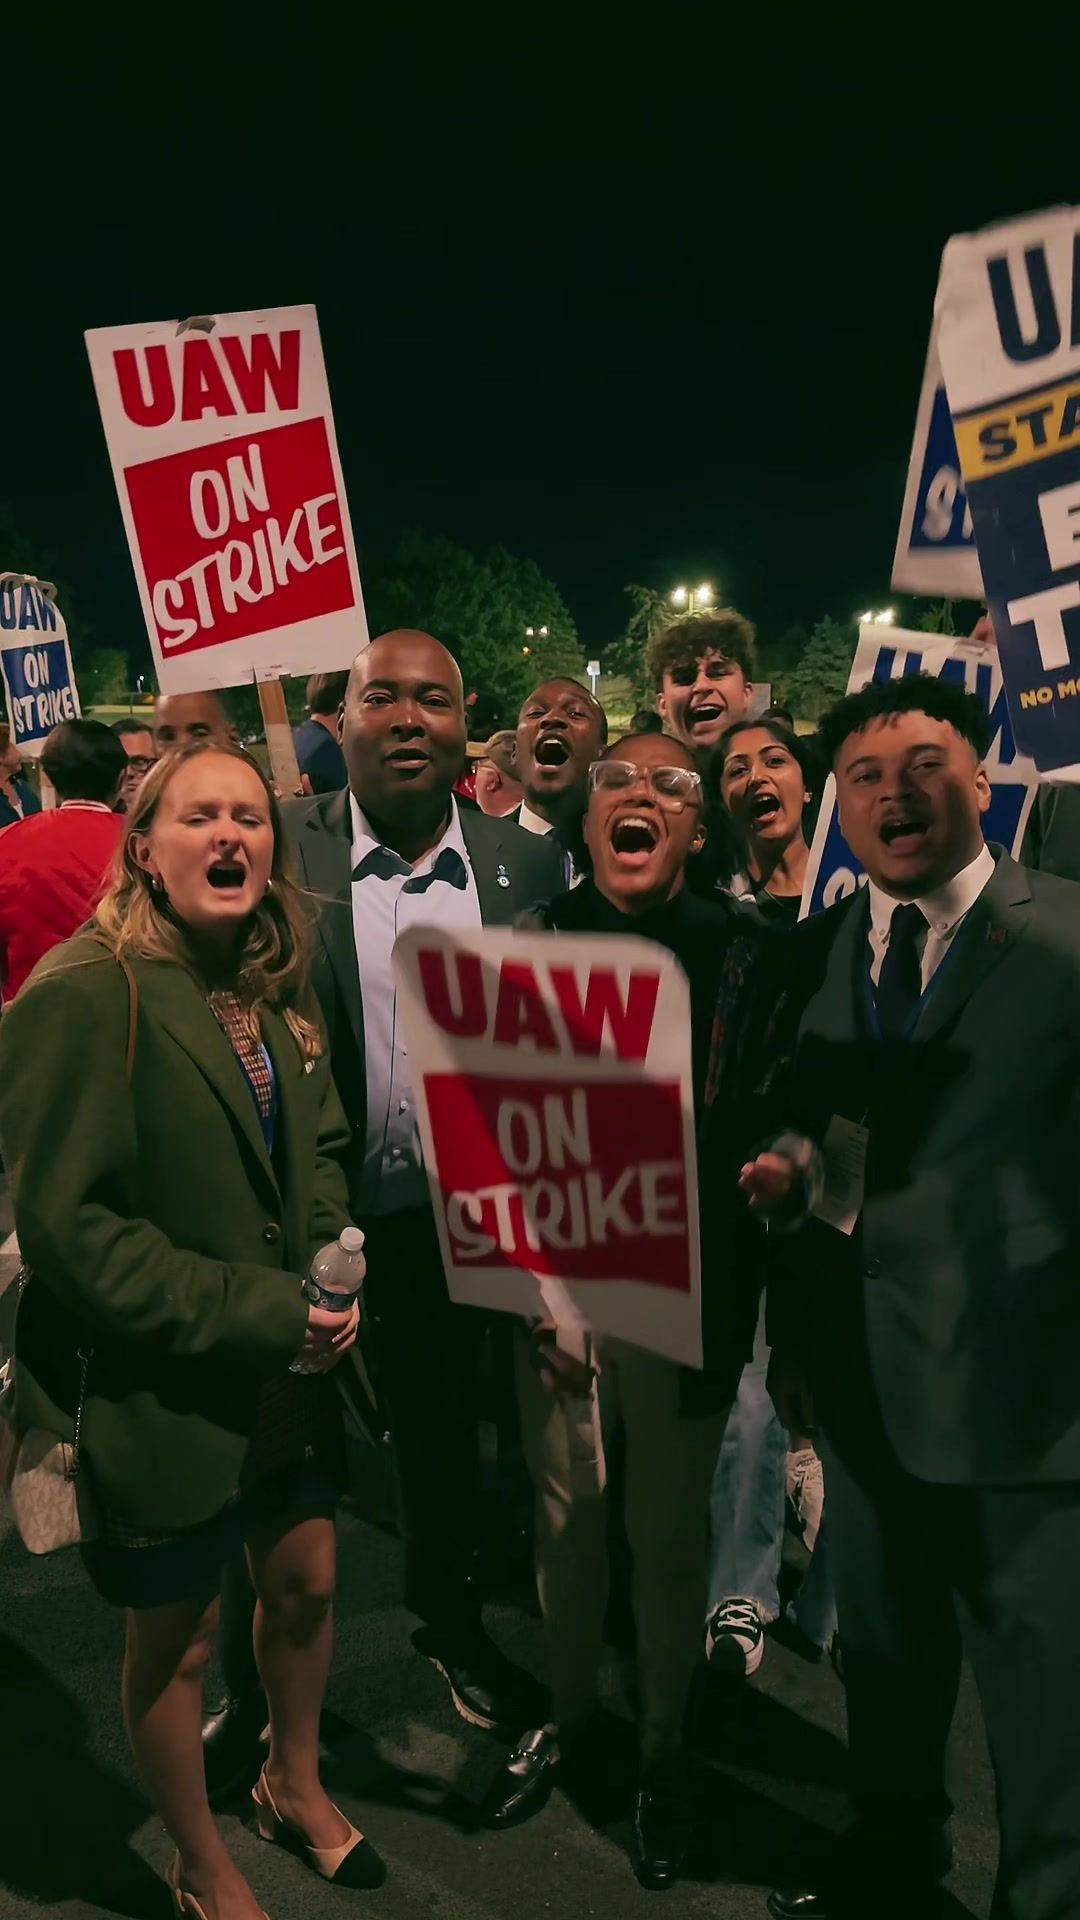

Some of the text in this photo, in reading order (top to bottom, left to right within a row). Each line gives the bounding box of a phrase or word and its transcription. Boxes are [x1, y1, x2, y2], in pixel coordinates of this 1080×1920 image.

[986, 233, 1080, 366] U
[112, 330, 301, 427] UAW
[189, 443, 270, 540] ON
[152, 492, 345, 649] STRIKE
[12, 686, 75, 734] STRIKE
[23, 650, 50, 688] ON
[1019, 678, 1080, 710] NO M
[416, 948, 661, 1070] UAW
[497, 1088, 592, 1176] ON
[446, 1163, 687, 1258] STRIKE
